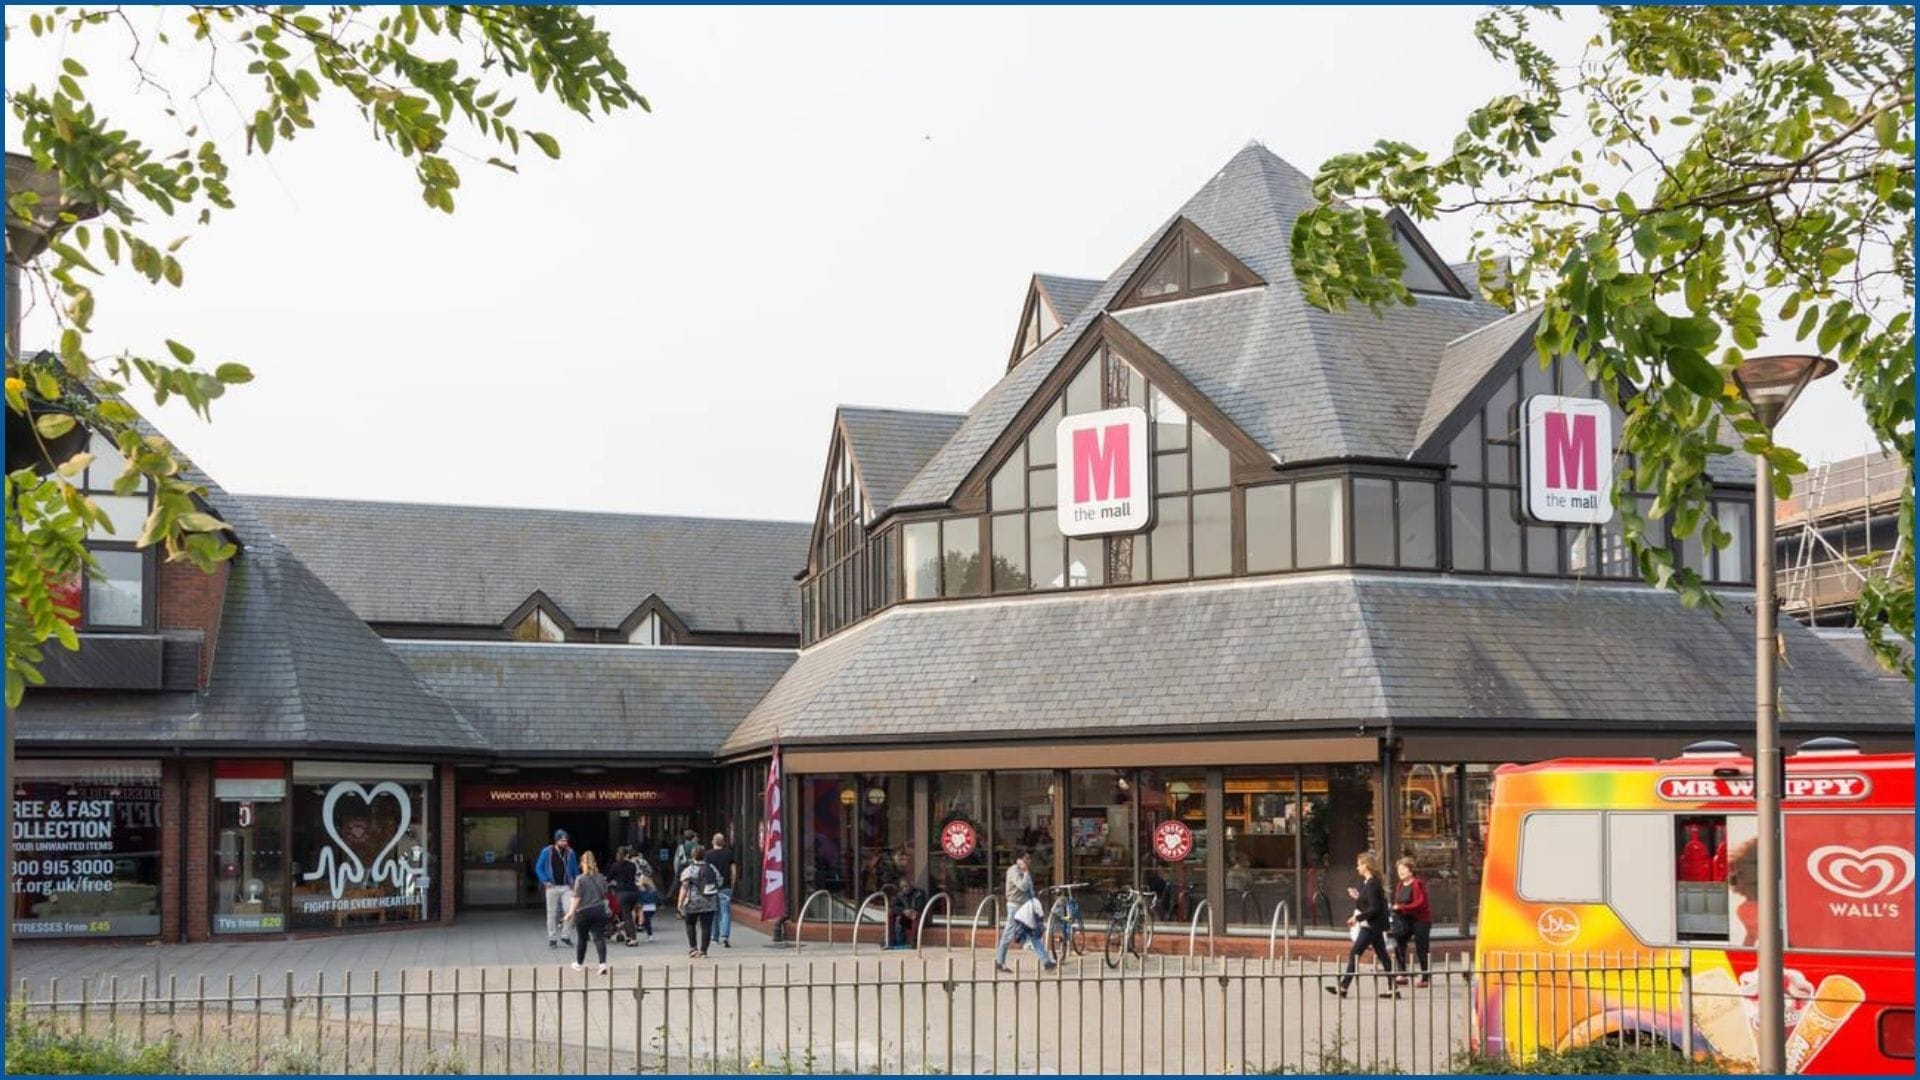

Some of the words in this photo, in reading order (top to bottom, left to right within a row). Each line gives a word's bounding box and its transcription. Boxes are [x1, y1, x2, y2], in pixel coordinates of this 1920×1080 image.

[1545, 412, 1597, 491] M
[1073, 423, 1131, 503] M
[1546, 493, 1566, 507] the
[1571, 496, 1598, 509] mall
[1074, 507, 1096, 521] the
[1101, 502, 1131, 519] mall
[1671, 780, 1718, 796] MR
[1725, 779, 1858, 796] WIPPY
[490, 790, 539, 801] Welcome
[541, 791, 551, 801] to
[555, 791, 574, 800] The
[575, 791, 596, 800] Mall
[598, 790, 665, 800] Walthamsto
[48, 801, 64, 818] &
[67, 801, 113, 818] FAST
[1160, 824, 1185, 835] COSTA
[36, 842, 84, 851] UNWANTED
[86, 841, 113, 850] ITEMS
[42, 860, 69, 875] 915
[72, 860, 113, 874] 3000
[303, 901, 330, 913] FIGHT
[332, 900, 350, 911] FOR
[351, 898, 379, 910] EVERY
[1829, 903, 1899, 917] WALL'S
[65, 922, 88, 933] from
[219, 919, 237, 929] TVs
[238, 918, 260, 928] from
[262, 917, 281, 928] £20
